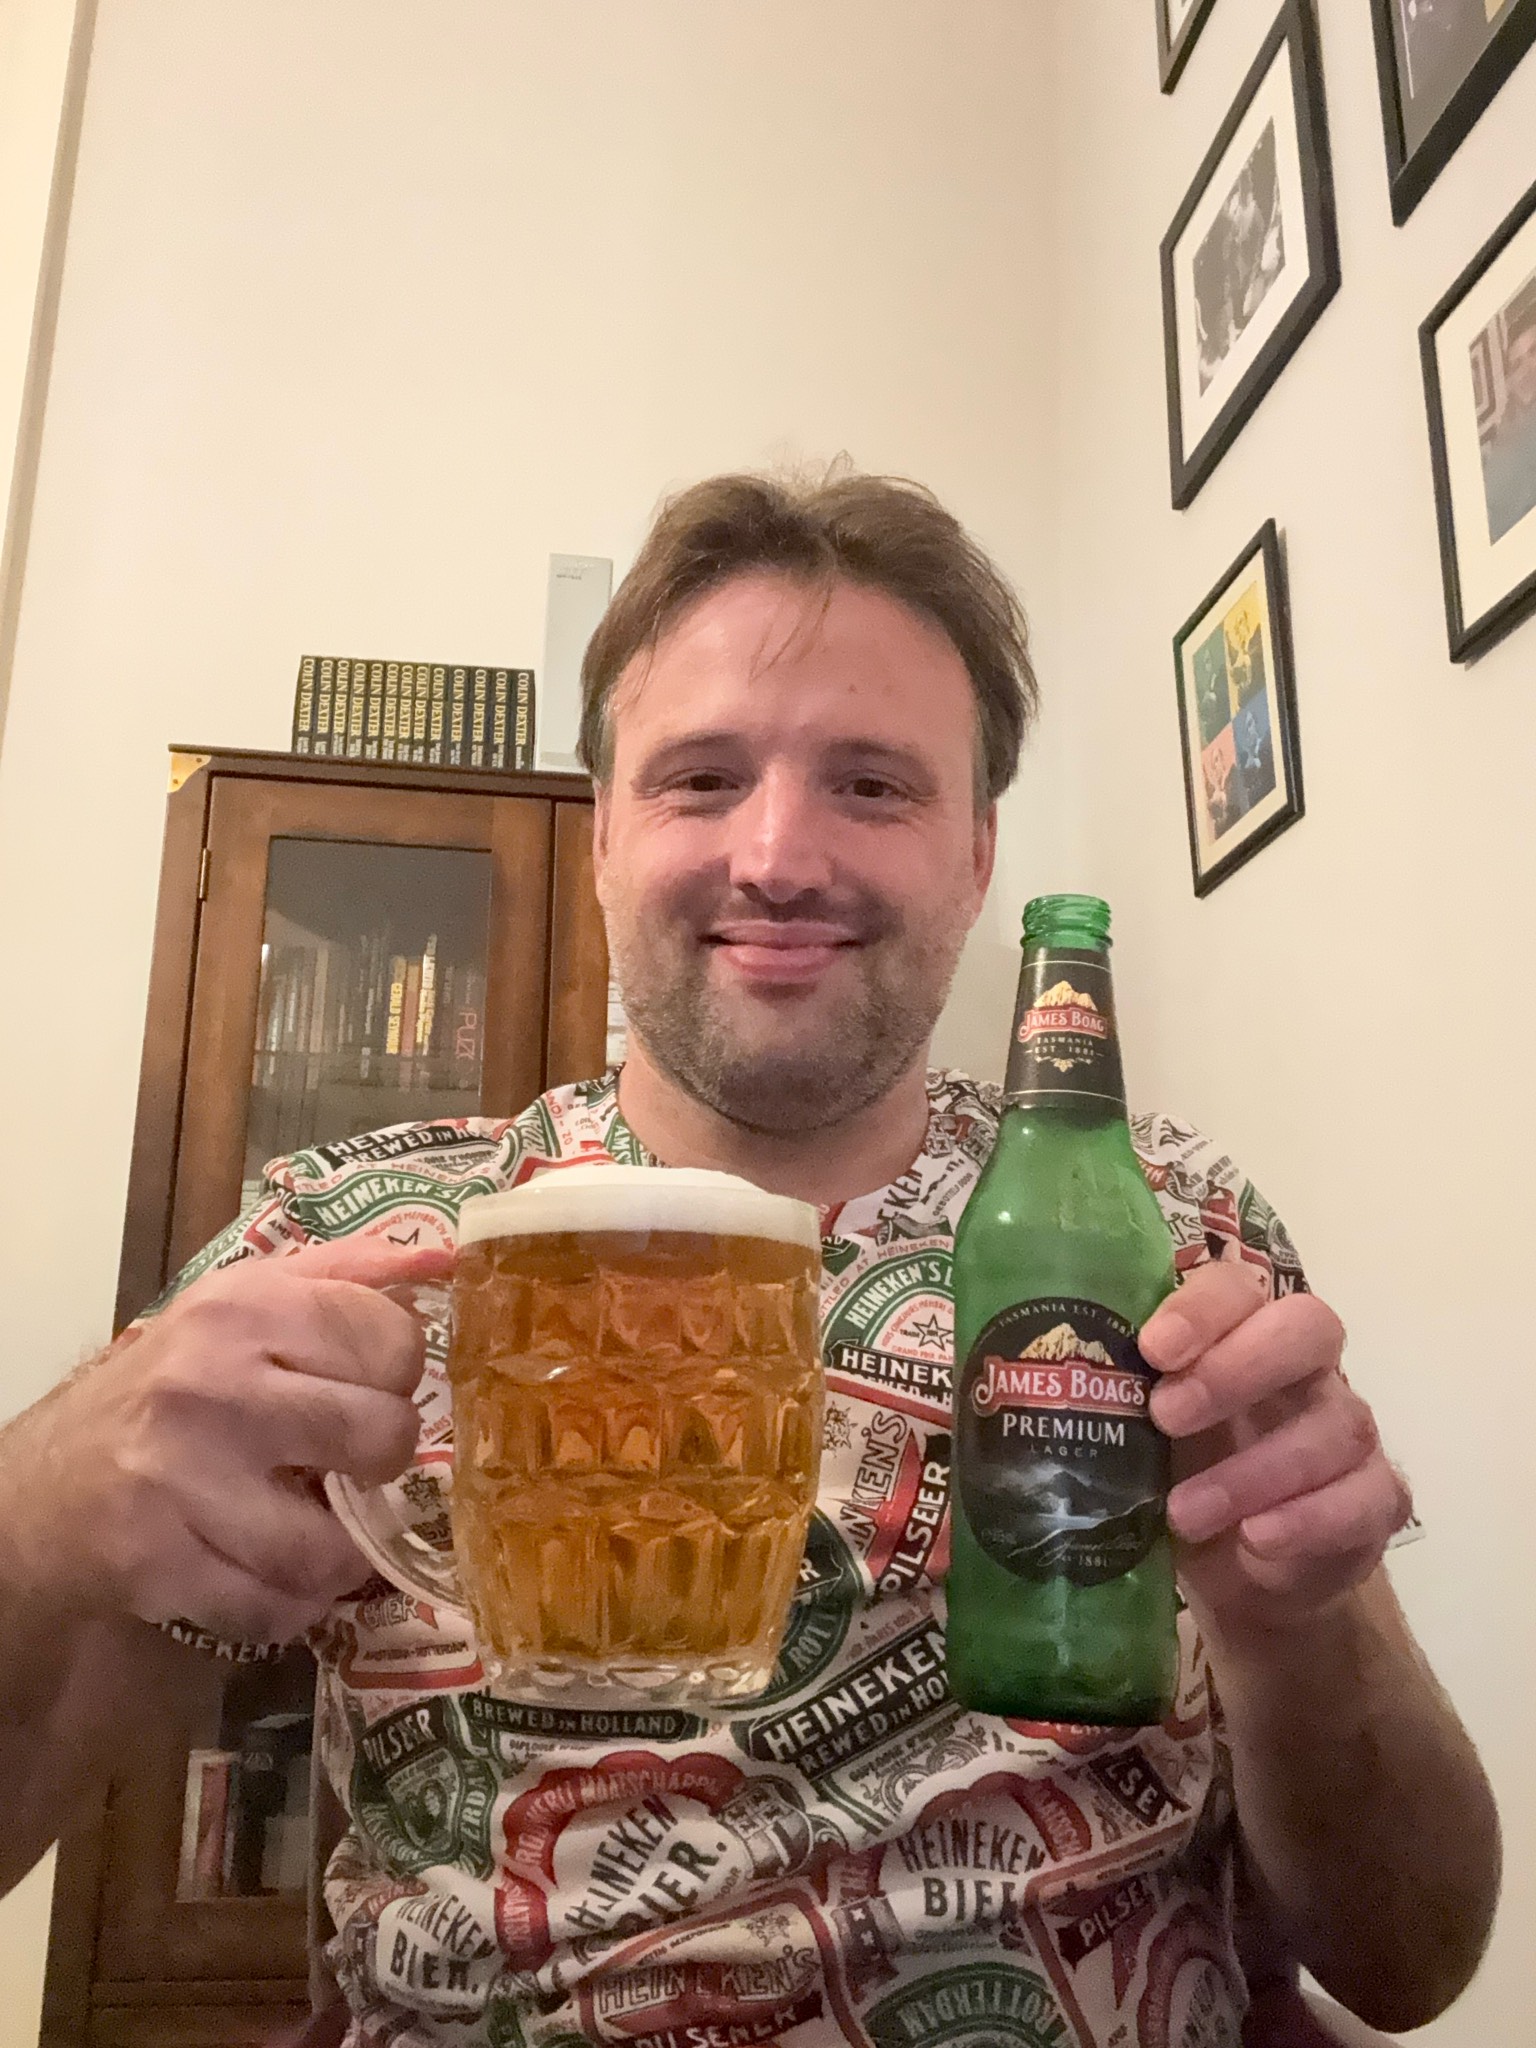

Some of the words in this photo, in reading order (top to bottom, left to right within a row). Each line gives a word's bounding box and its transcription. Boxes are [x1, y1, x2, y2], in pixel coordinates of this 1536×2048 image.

[302, 659, 314, 690] COLIN
[320, 660, 333, 691] COLIN
[337, 660, 349, 691] COLIN
[354, 663, 366, 694] COLIN
[371, 664, 383, 694] COLIN
[386, 664, 399, 695] COLIN
[401, 665, 413, 696] COLIN
[416, 666, 428, 699] COLIN
[433, 668, 444, 699] COLIN
[454, 669, 465, 700] COLIN
[475, 670, 486, 700] COLIN
[496, 672, 507, 702] COLIN
[517, 673, 529, 704] COLIN
[299, 693, 312, 731] DEXTER
[317, 694, 330, 734] DEXTER
[334, 694, 346, 734] DEXTER
[351, 697, 363, 736] DEXTER
[368, 698, 381, 737] DEXTER
[384, 698, 396, 736] DEXTER
[399, 699, 411, 739] DEXTER
[414, 701, 426, 739] DEXTER
[430, 702, 443, 741] DEXTER
[451, 703, 464, 742] DEXTER
[472, 703, 485, 742] DEXTER
[494, 705, 506, 744] DEXTER
[516, 706, 527, 745] DEXTER
[1020, 1011, 1067, 1036] JAMES
[1036, 1036, 1093, 1046] TASMANIA
[341, 1131, 433, 1165] BREWED
[436, 1130, 453, 1143] IN
[314, 1177, 457, 1228] HEINEKEN'S
[856, 1259, 869, 1273] AT
[845, 1260, 942, 1329] HEINEKEN'S
[998, 1303, 1067, 1329] TASMANIA
[841, 1348, 954, 1389] HEINEK
[975, 1363, 1062, 1405] JAMES
[1070, 1368, 1145, 1406] BOAG'S
[1002, 1411, 1125, 1447] PREMIUM
[1030, 1442, 1098, 1459] LAGER
[473, 1699, 555, 1729] BREWED
[558, 1719, 576, 1731] IN
[580, 1714, 677, 1736] HOLLAND
[801, 1712, 889, 1774] REWED
[892, 1703, 912, 1725] IN
[896, 1818, 1046, 1875] HEINEKEN
